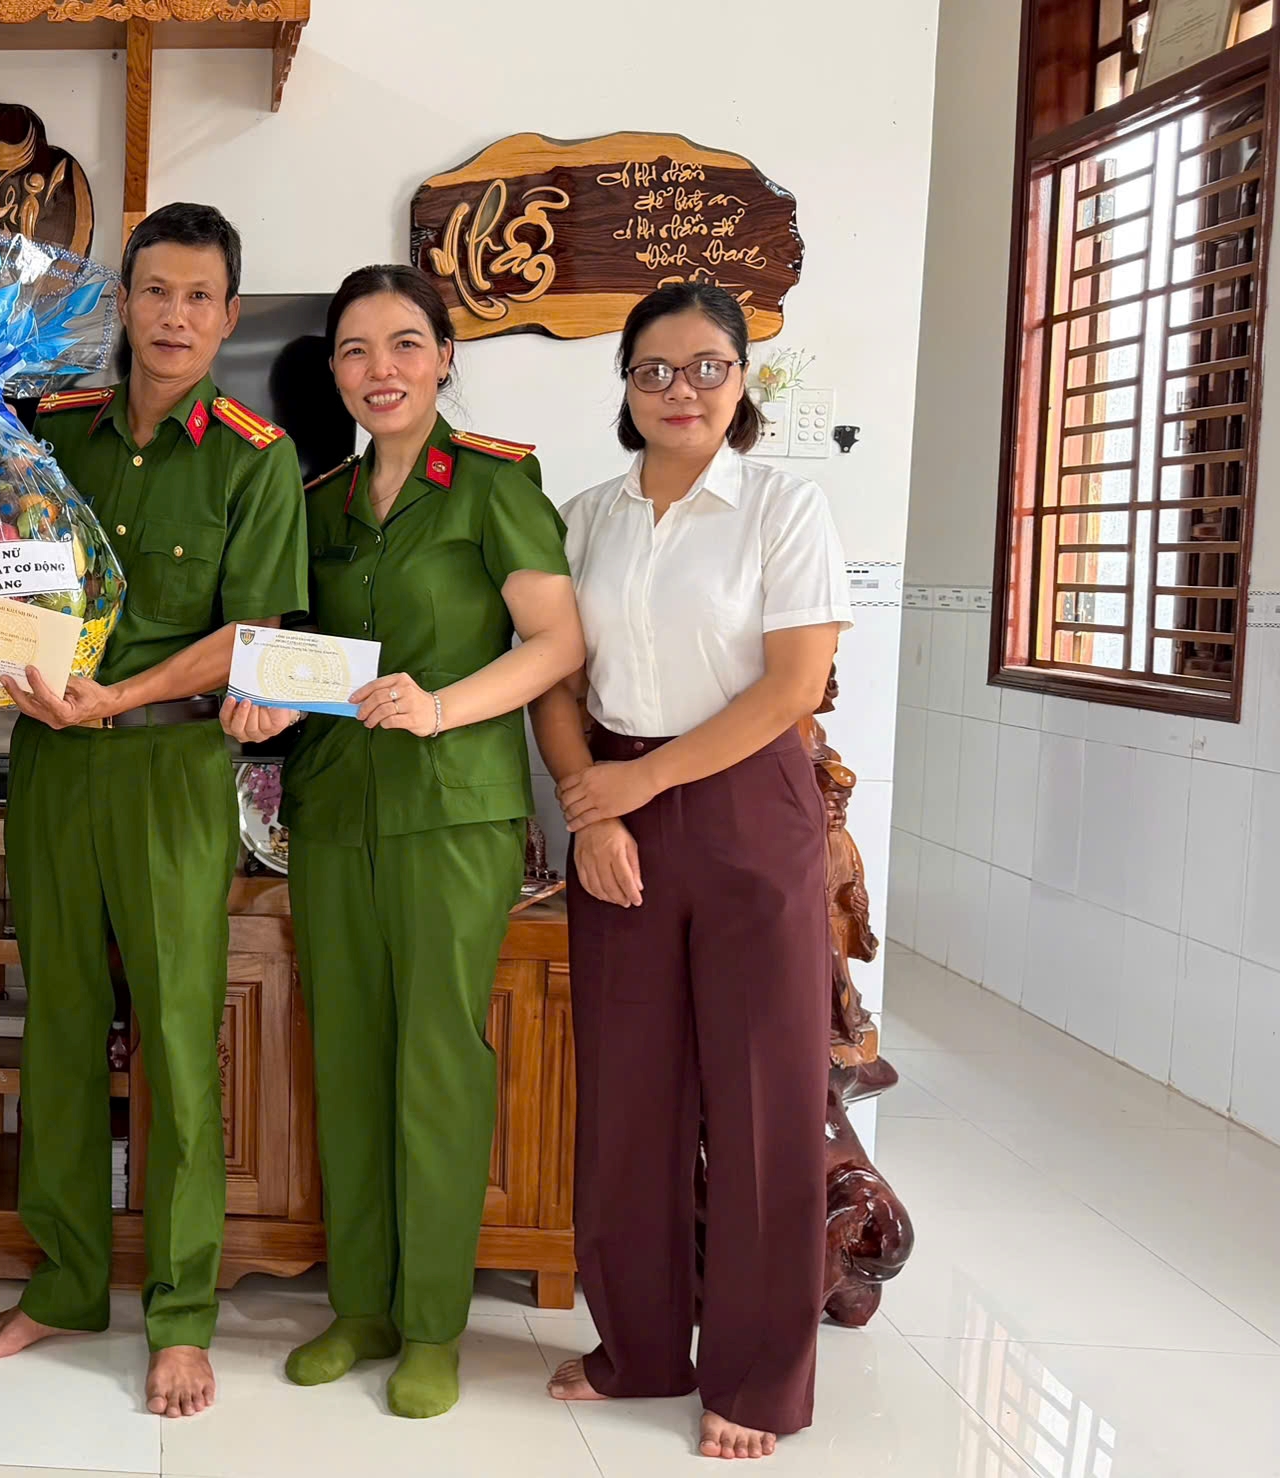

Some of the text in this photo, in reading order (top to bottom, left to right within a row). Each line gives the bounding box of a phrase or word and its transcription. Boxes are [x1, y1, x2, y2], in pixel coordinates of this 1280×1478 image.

[596, 161, 631, 188] Có
[635, 163, 657, 187] khi
[636, 215, 655, 240] khi
[430, 178, 569, 320] Nhẫn
[2, 547, 21, 560] NỮ
[14, 562, 32, 573] CƠ
[34, 561, 66, 574] ĐỘNG
